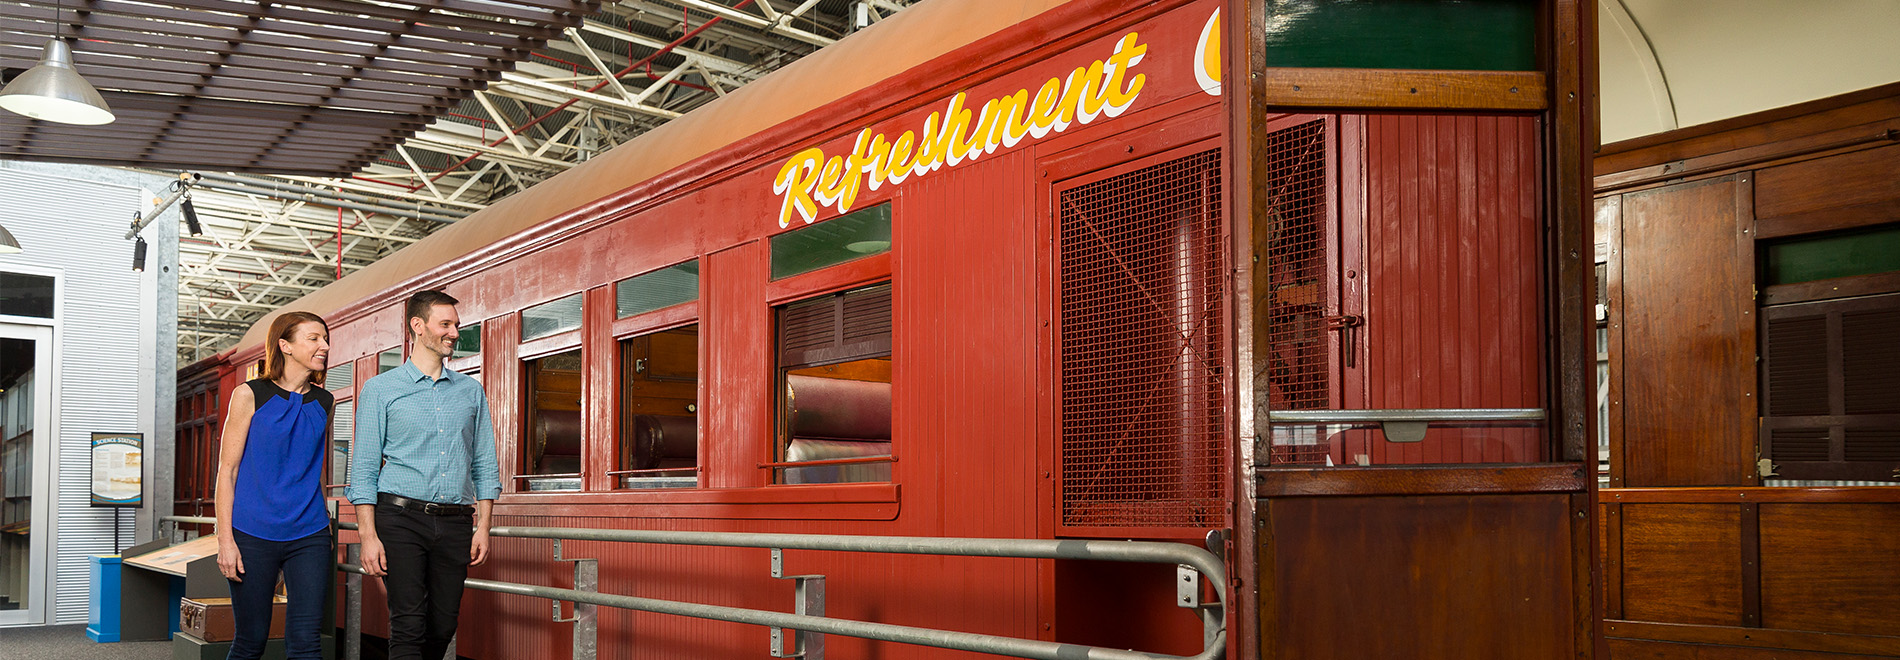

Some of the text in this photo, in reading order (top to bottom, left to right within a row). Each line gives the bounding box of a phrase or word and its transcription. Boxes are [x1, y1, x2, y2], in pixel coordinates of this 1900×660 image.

[773, 32, 1147, 228] Refreshment
[96, 437, 138, 446] SCIENCE STATION
